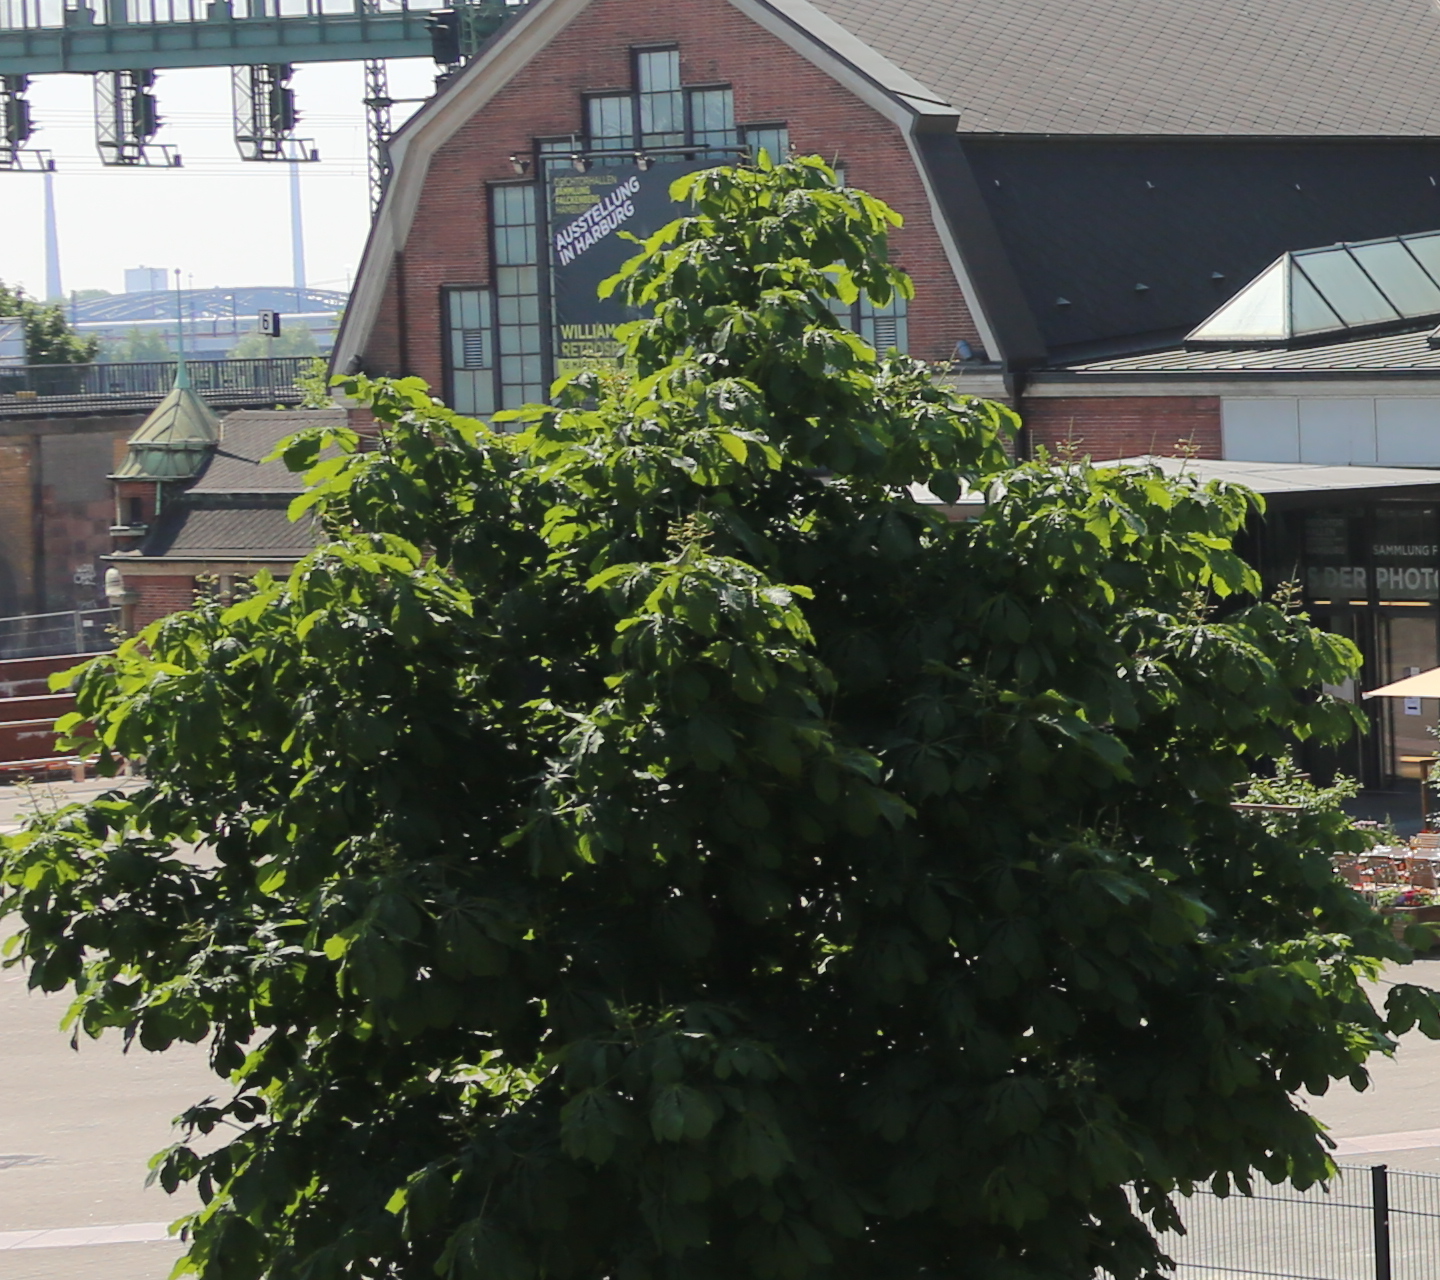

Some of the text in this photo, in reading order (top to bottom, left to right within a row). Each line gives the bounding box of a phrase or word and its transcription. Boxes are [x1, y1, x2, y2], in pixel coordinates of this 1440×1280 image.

[556, 176, 640, 251] AUSSTELLUNG
[559, 200, 635, 266] IN HARBURG
[262, 313, 269, 330] 6
[560, 323, 616, 340] WILLIAM
[1372, 544, 1429, 556] SAMMLUNG
[1324, 566, 1367, 589] DER
